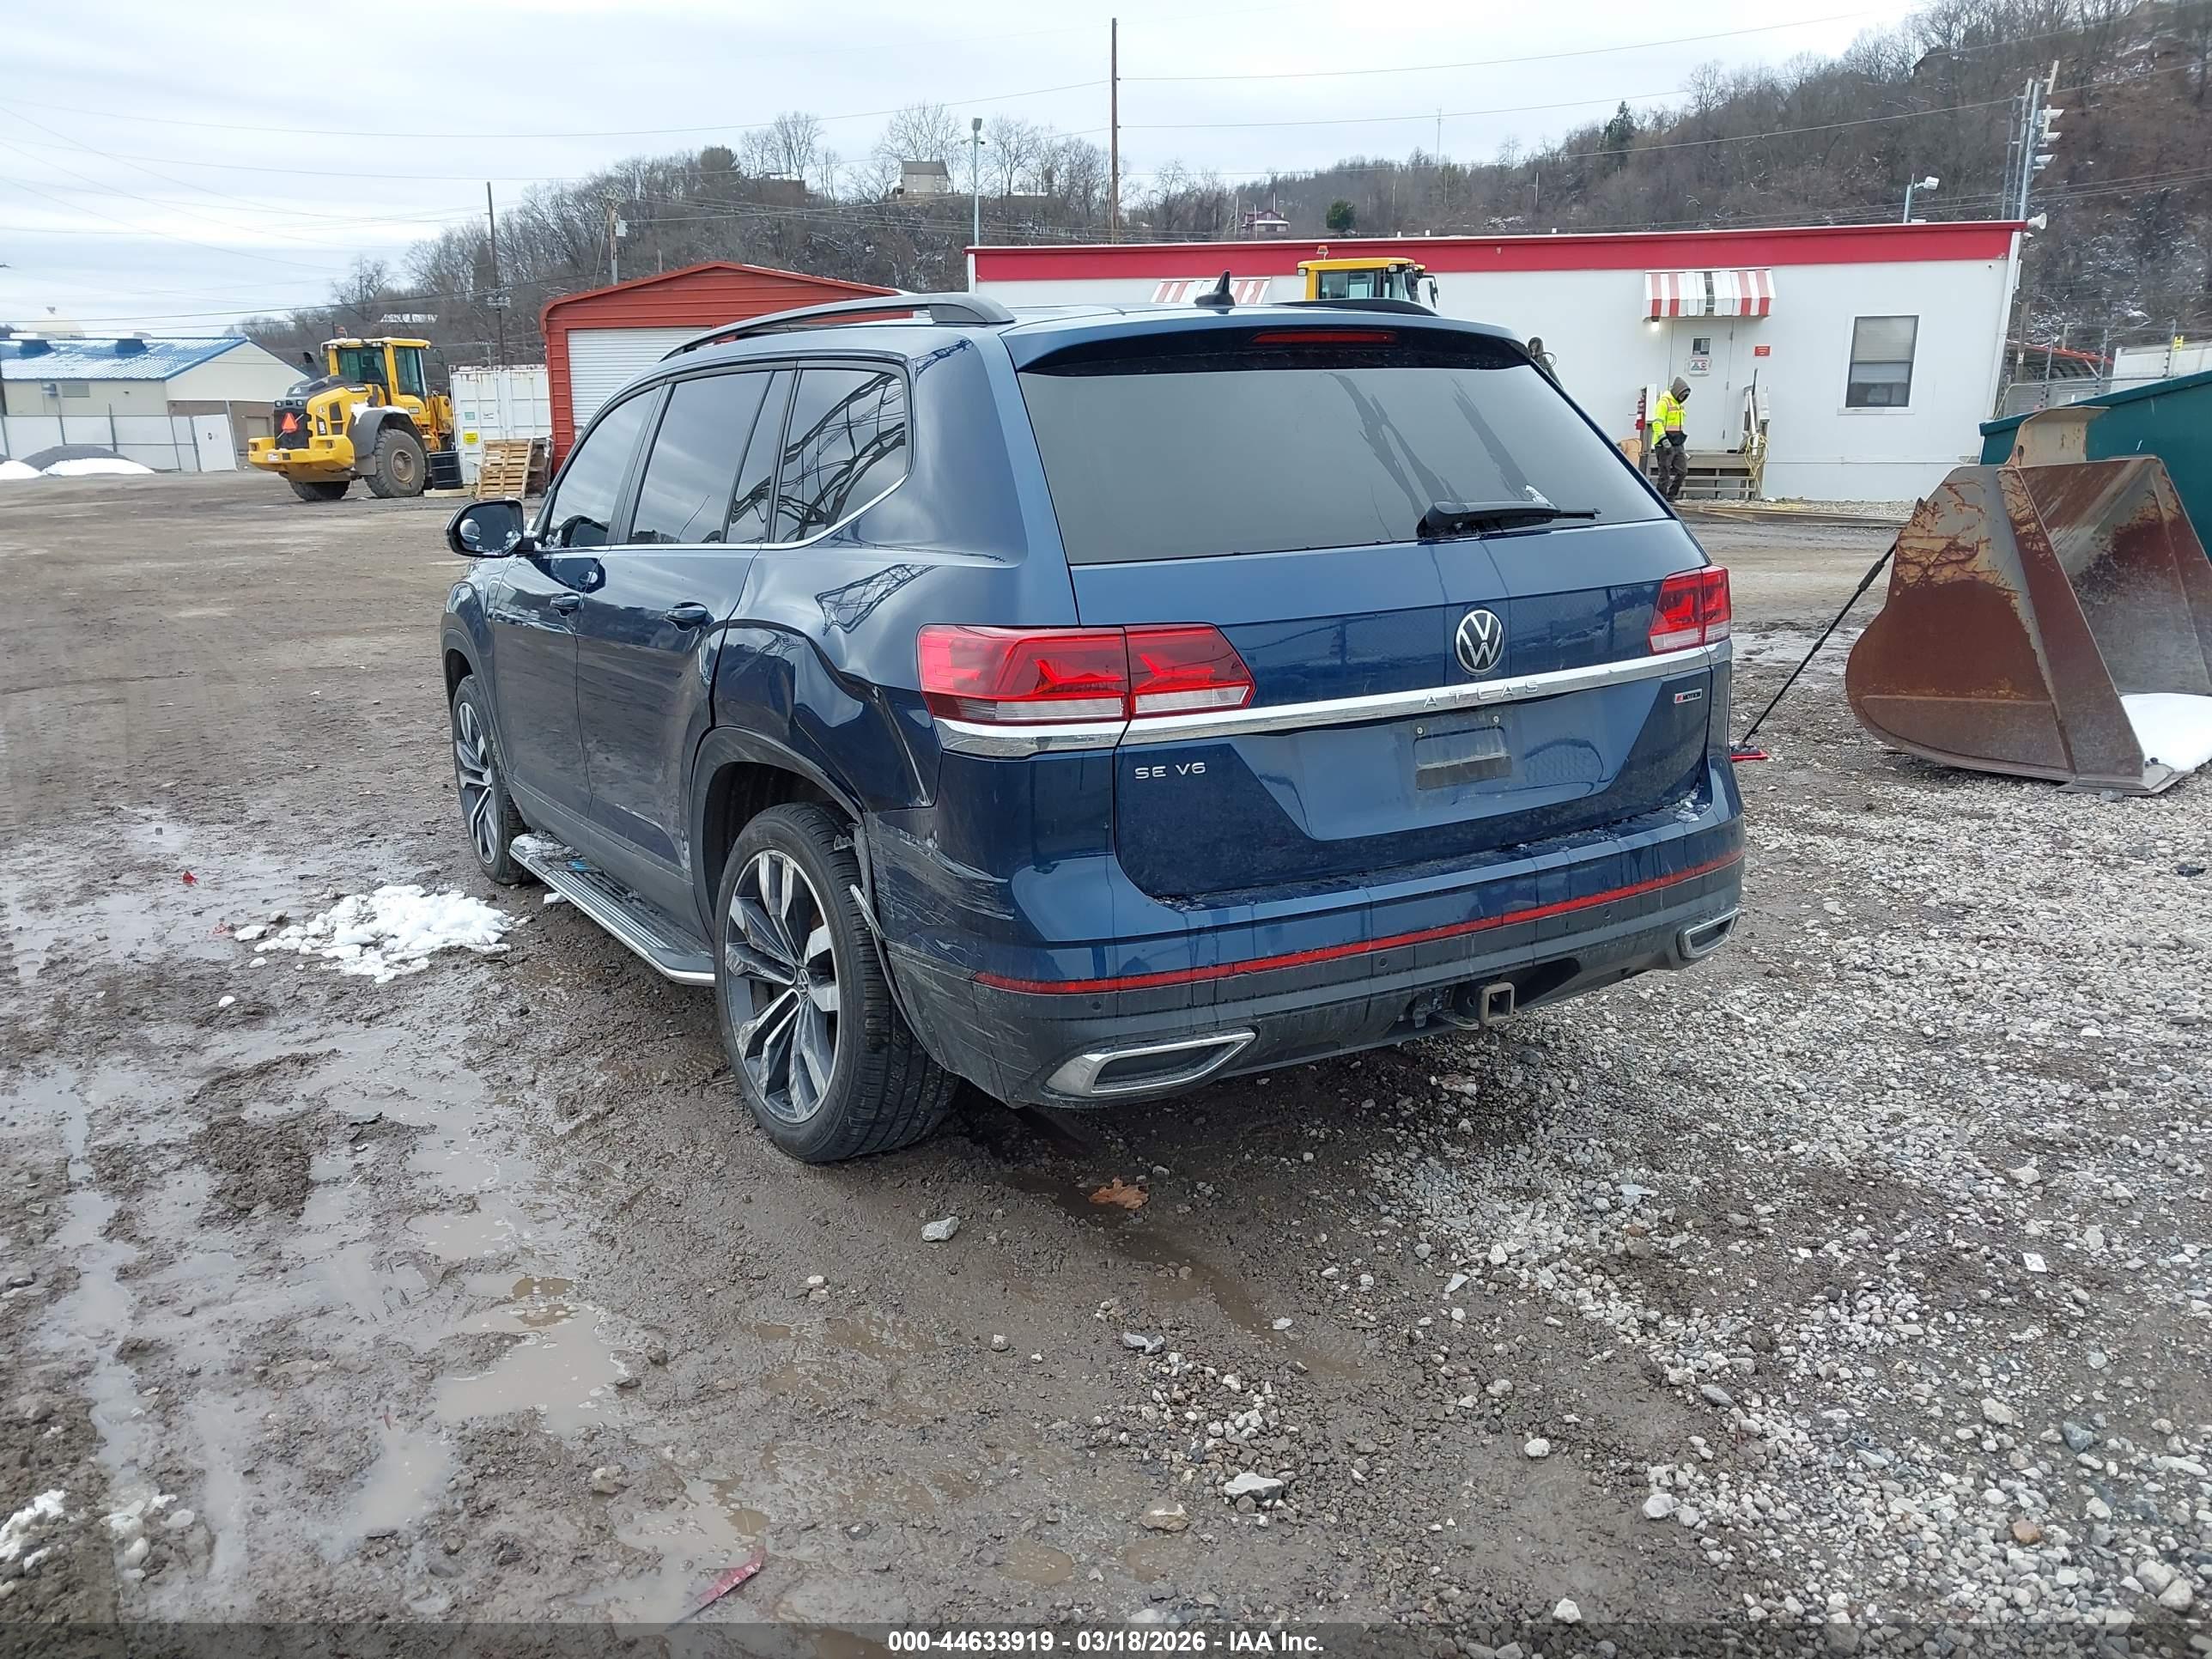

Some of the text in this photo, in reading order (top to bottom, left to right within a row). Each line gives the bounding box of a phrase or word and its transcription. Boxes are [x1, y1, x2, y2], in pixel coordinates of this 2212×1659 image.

[1423, 679, 1539, 708] ATLAS
[1134, 762, 1206, 780] SE V6
